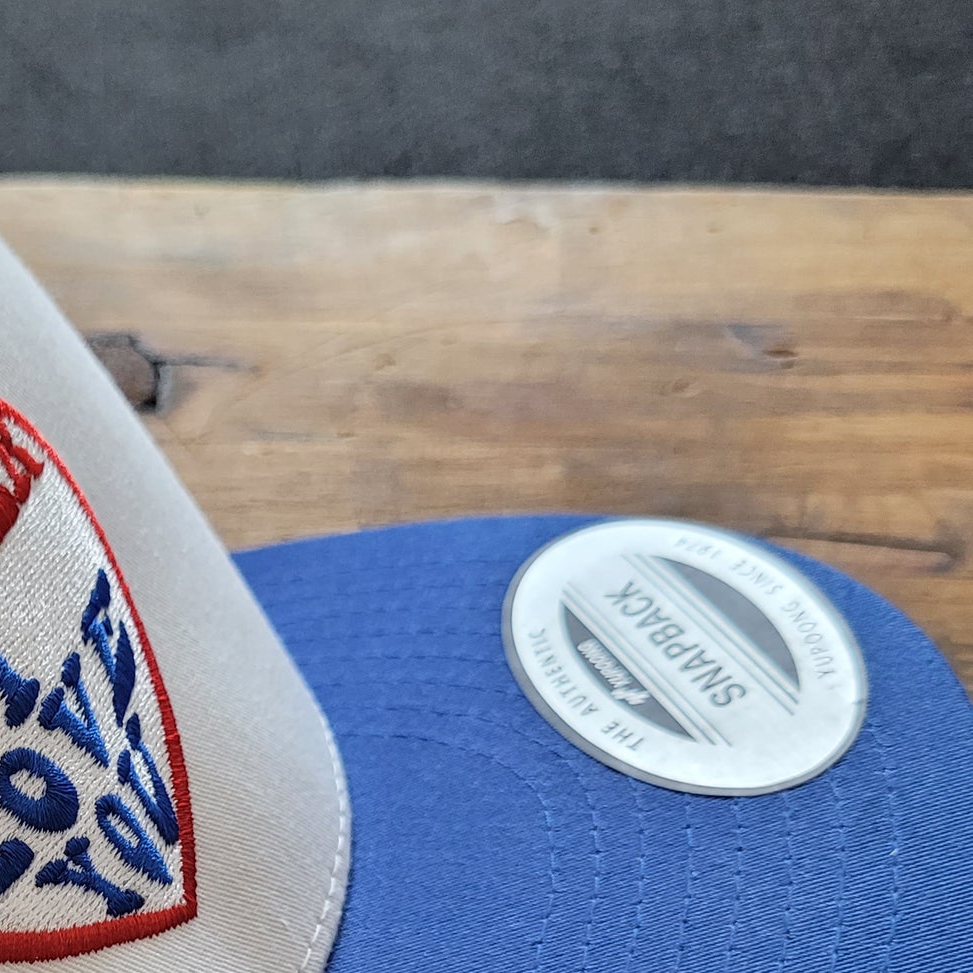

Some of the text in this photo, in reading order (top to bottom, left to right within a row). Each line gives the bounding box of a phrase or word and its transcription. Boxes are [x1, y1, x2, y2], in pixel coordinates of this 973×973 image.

[728, 559, 783, 596] SINCE
[528, 628, 644, 751] THE AUTHENTIC
[604, 581, 747, 709] SNAPBACK
[781, 602, 836, 680] YUPOONG
[36, 713, 179, 917] YOU
